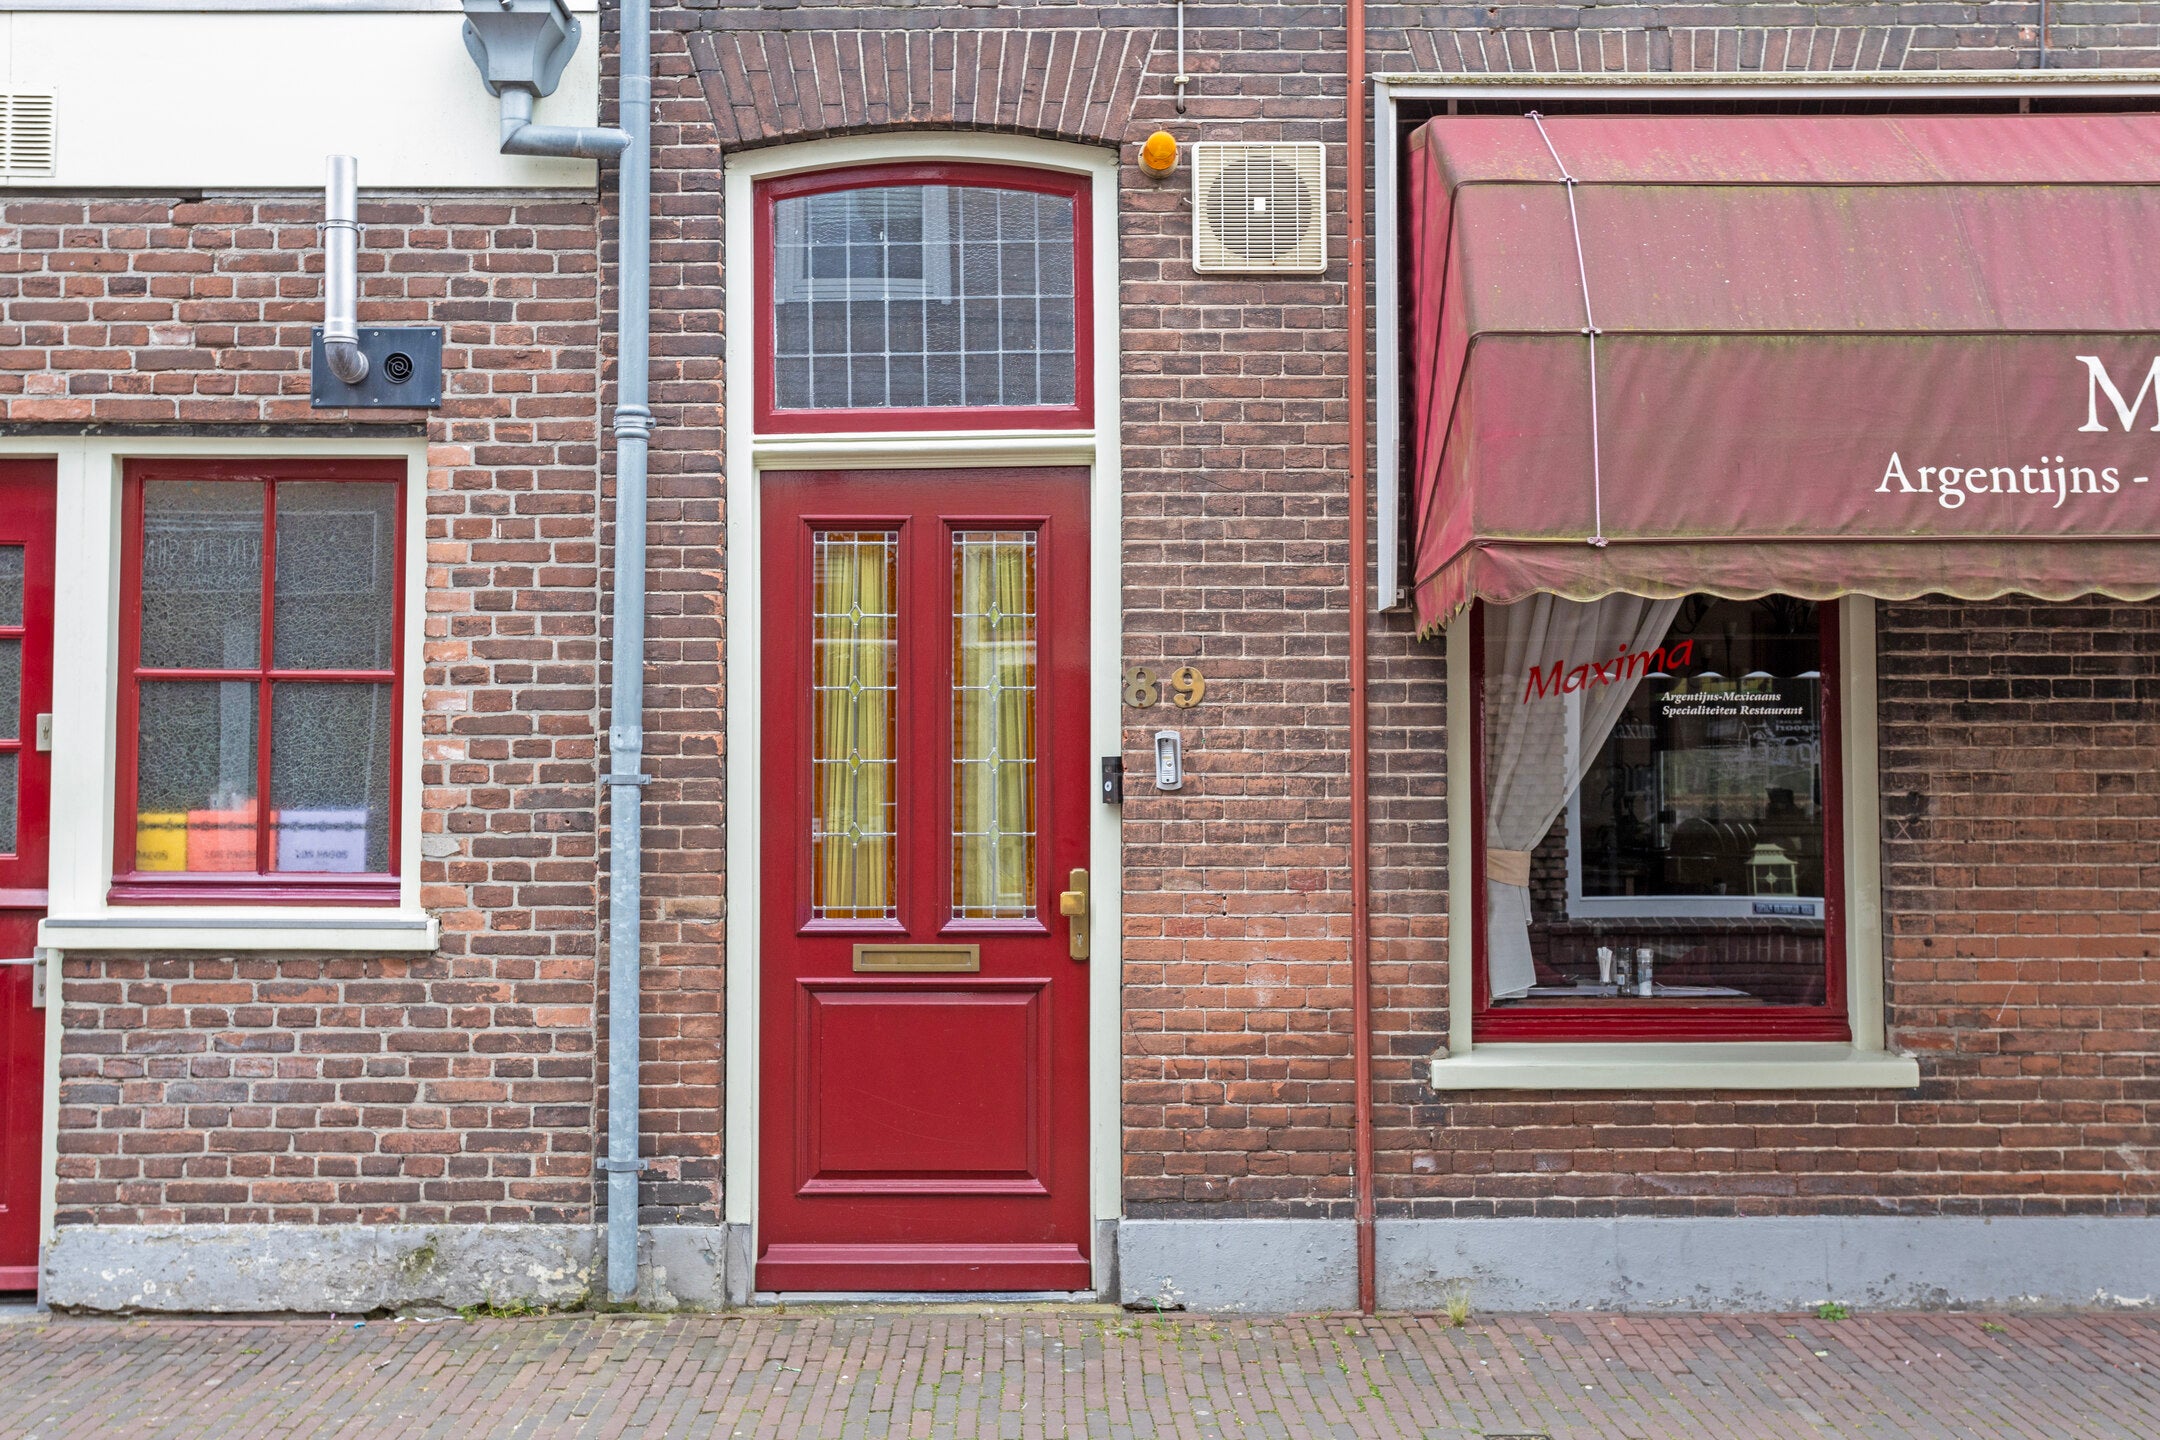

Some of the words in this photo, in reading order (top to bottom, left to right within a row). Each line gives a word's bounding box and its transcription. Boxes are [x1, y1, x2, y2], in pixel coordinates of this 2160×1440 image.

[1874, 451, 2120, 508] Argentijns
[1124, 666, 1205, 708] 89
[1523, 638, 1694, 704] Maxima
[1661, 691, 1781, 703] Argentijns-Mexicaans
[1662, 705, 1737, 718] Specialiteiten
[1740, 705, 1803, 716] Restaurant
